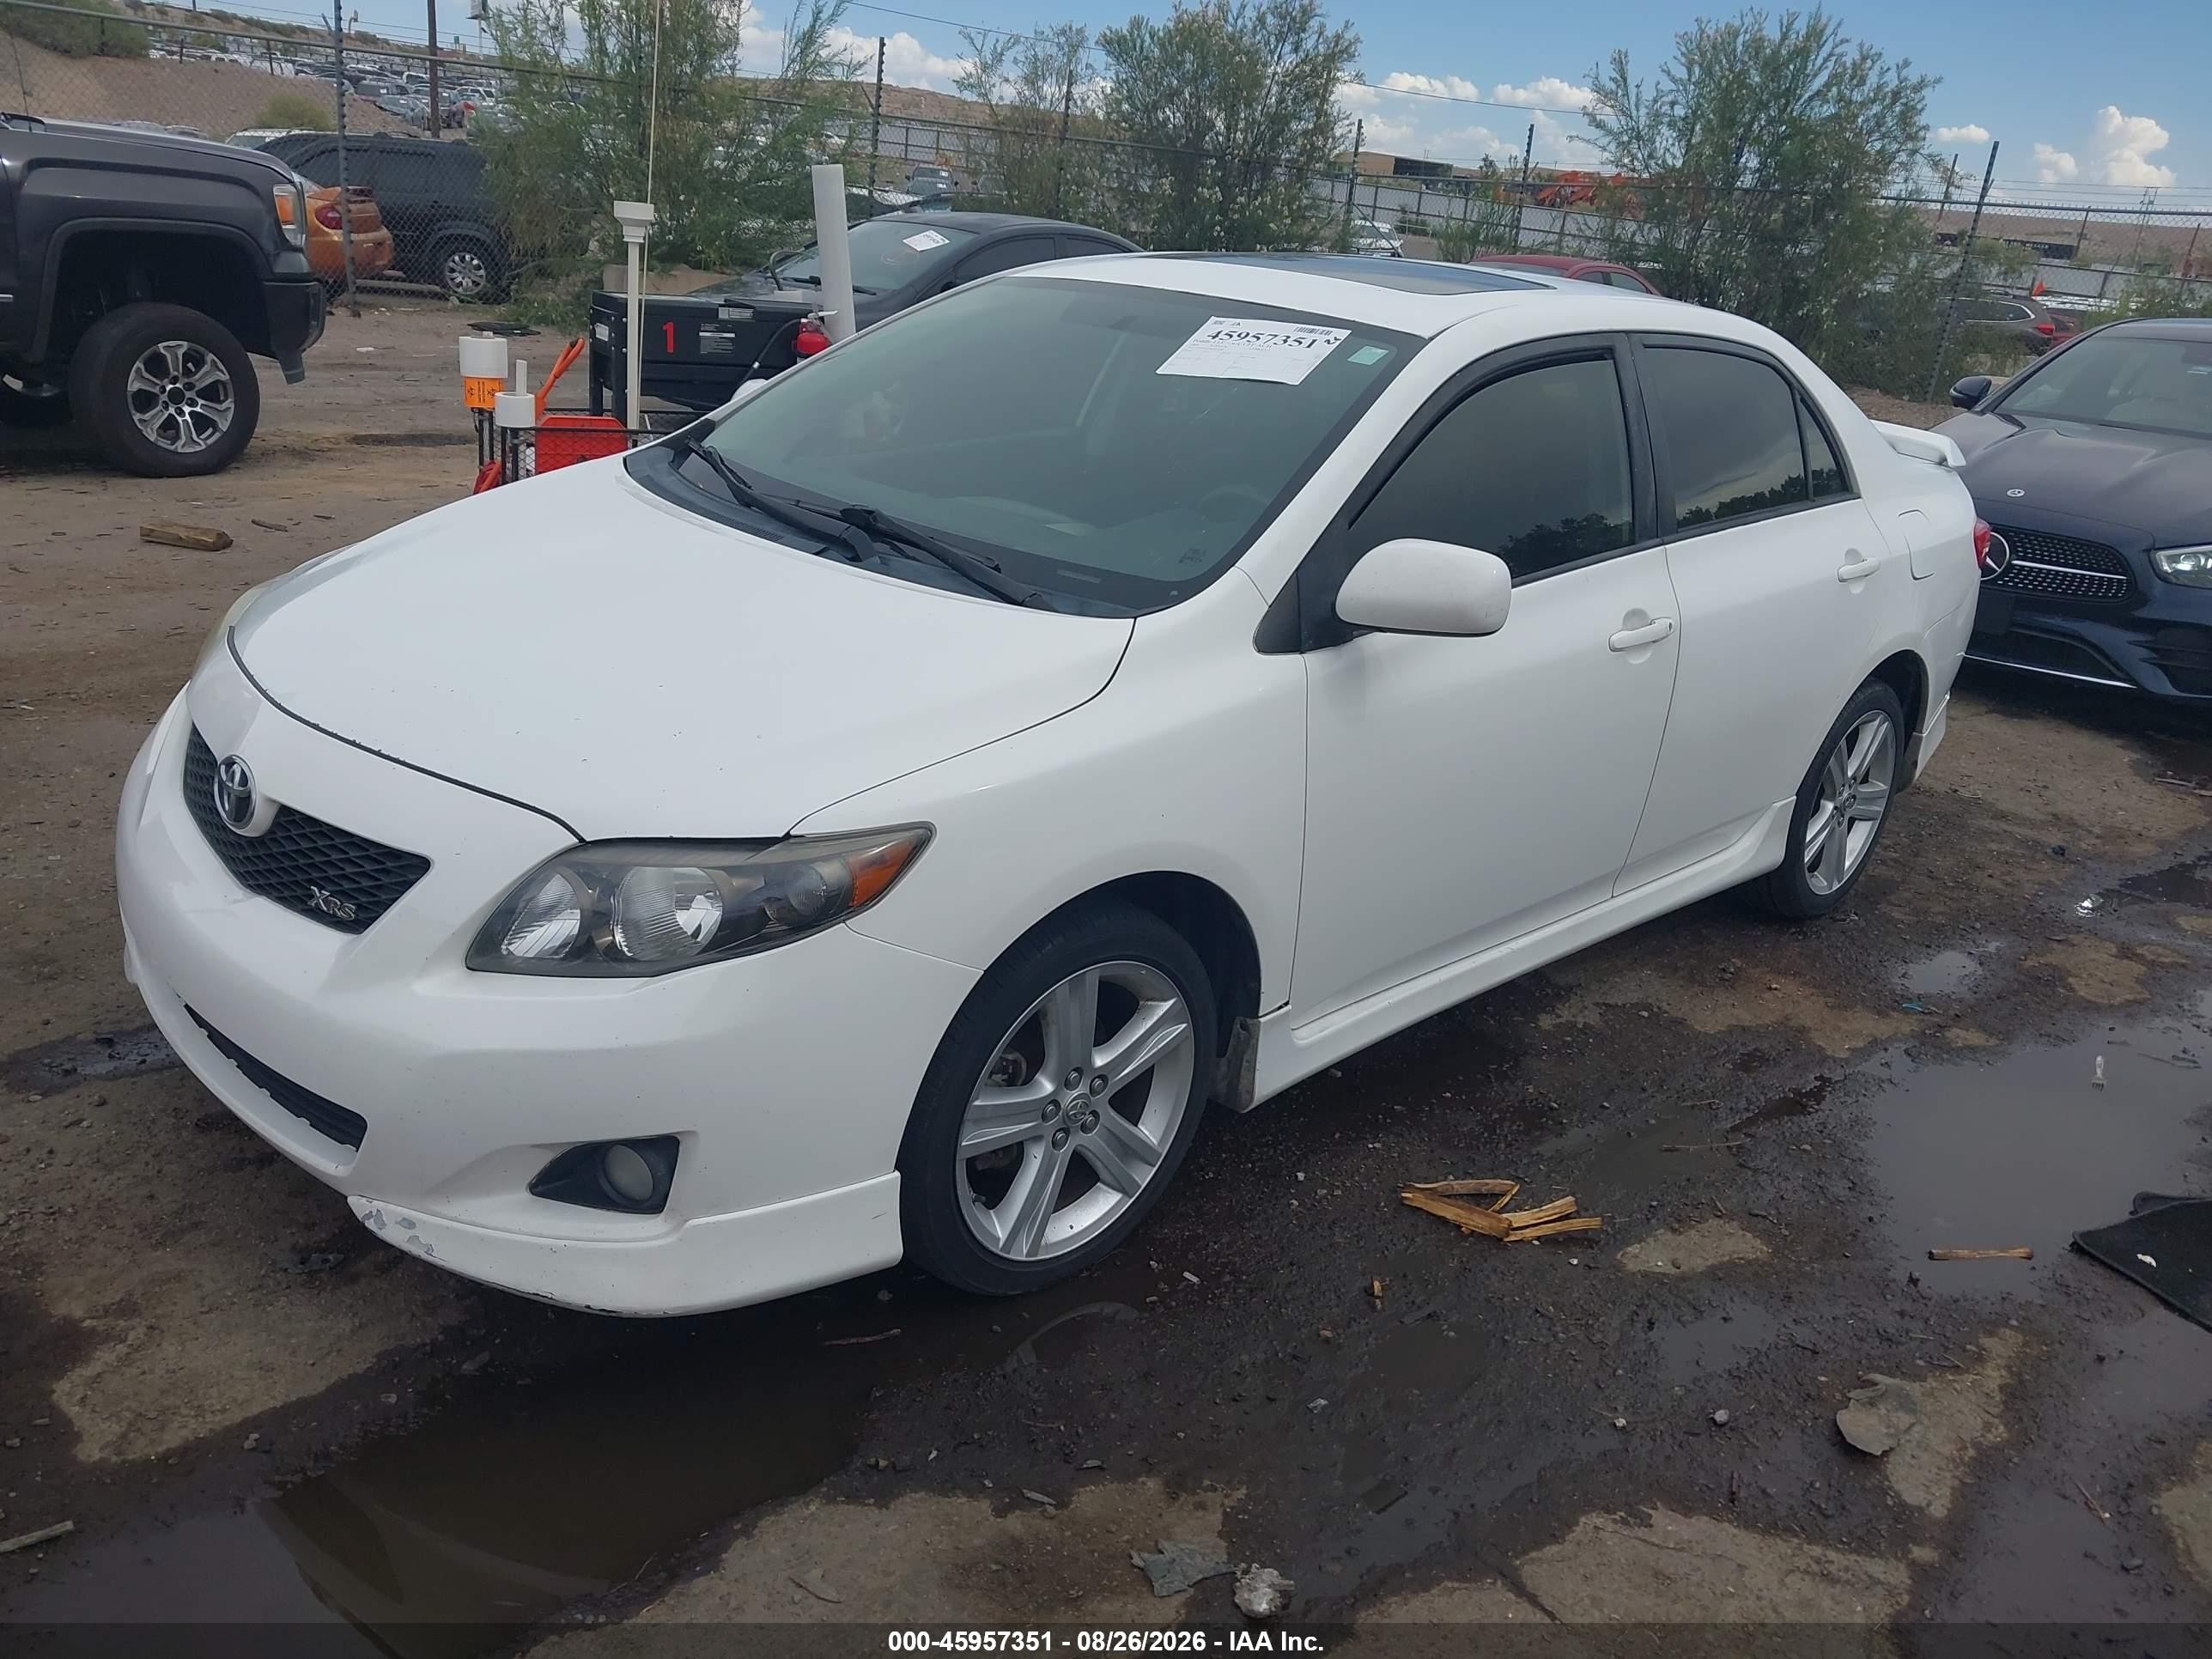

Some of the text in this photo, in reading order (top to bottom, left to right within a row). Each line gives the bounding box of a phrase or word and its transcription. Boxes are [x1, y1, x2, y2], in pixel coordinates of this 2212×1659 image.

[663, 321, 676, 354] 1
[1206, 330, 1317, 349] 45957351
[307, 886, 355, 921] XRS
